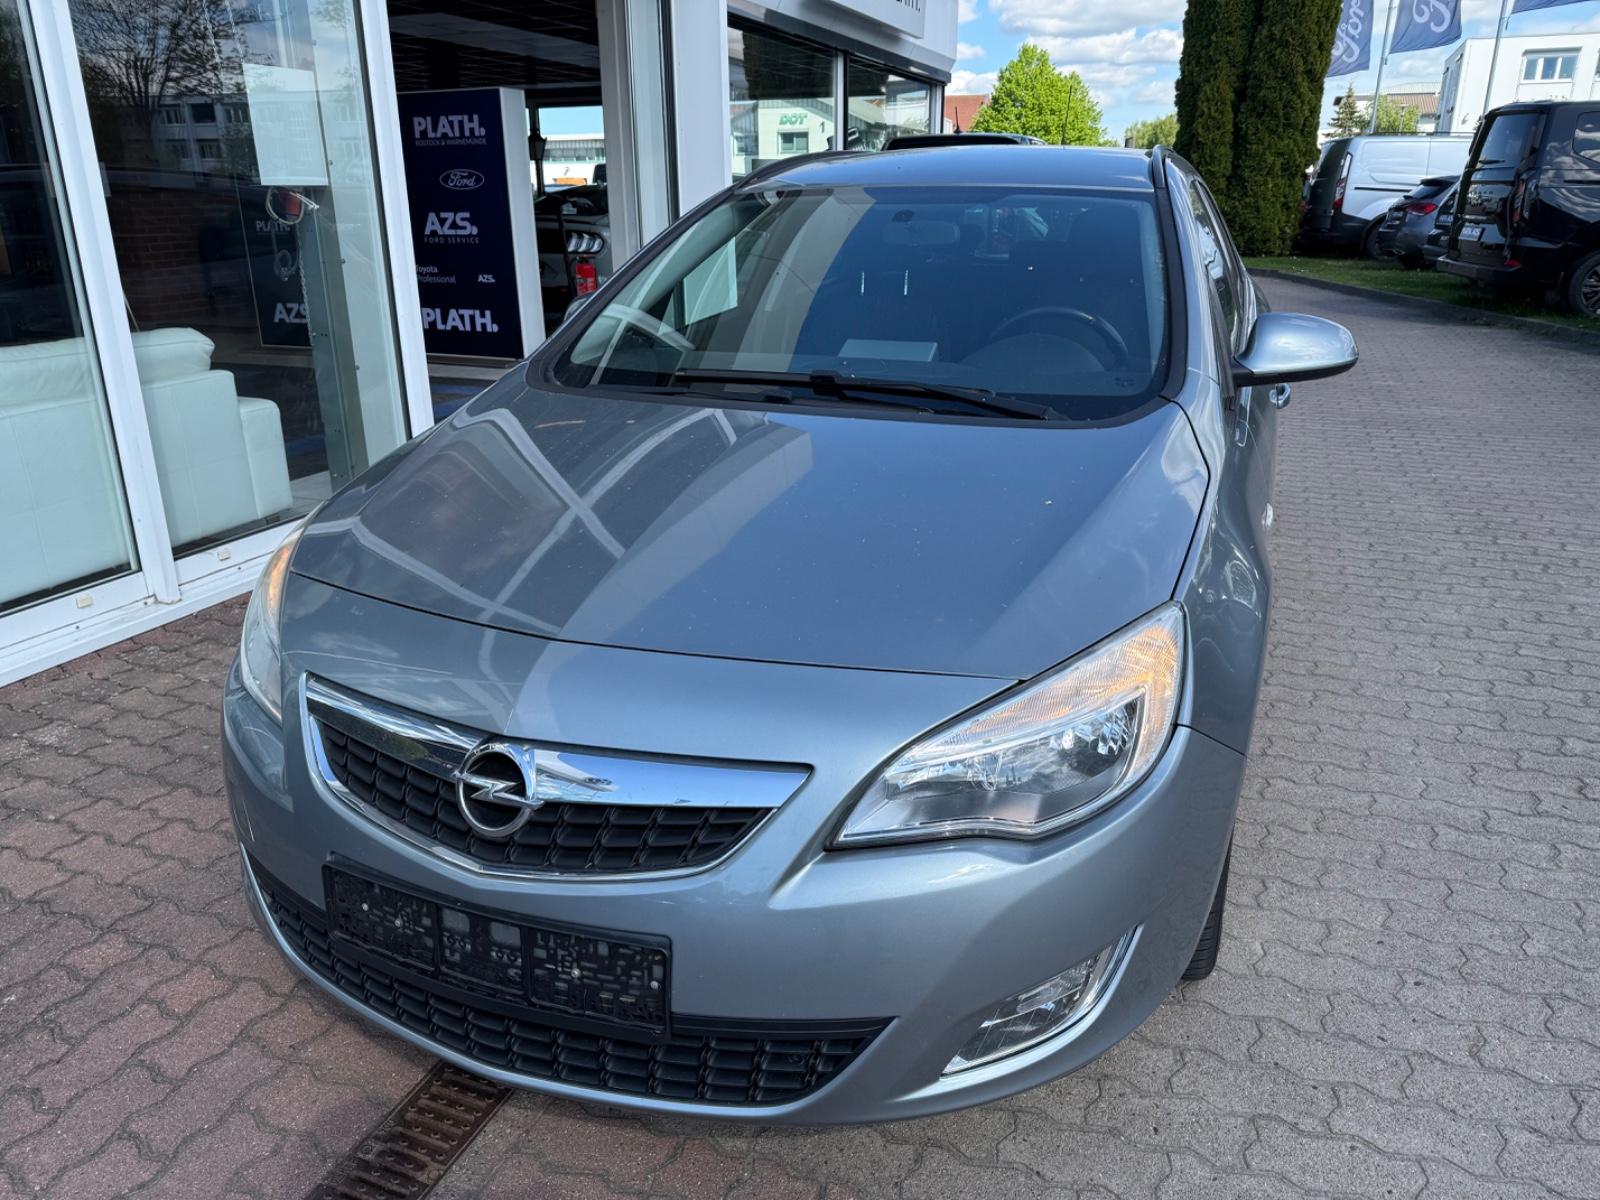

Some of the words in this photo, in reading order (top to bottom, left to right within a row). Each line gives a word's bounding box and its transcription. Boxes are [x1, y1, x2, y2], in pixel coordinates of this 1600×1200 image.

[1331, 0, 1364, 63] For
[412, 114, 486, 139] PLATH.
[778, 112, 809, 125] DOT
[447, 171, 476, 187] Ford
[424, 211, 478, 235] AZS.
[424, 236, 445, 245] FORD
[447, 236, 480, 245] SERVICE
[477, 273, 496, 283] AZS.
[421, 306, 499, 333] PLATH.
